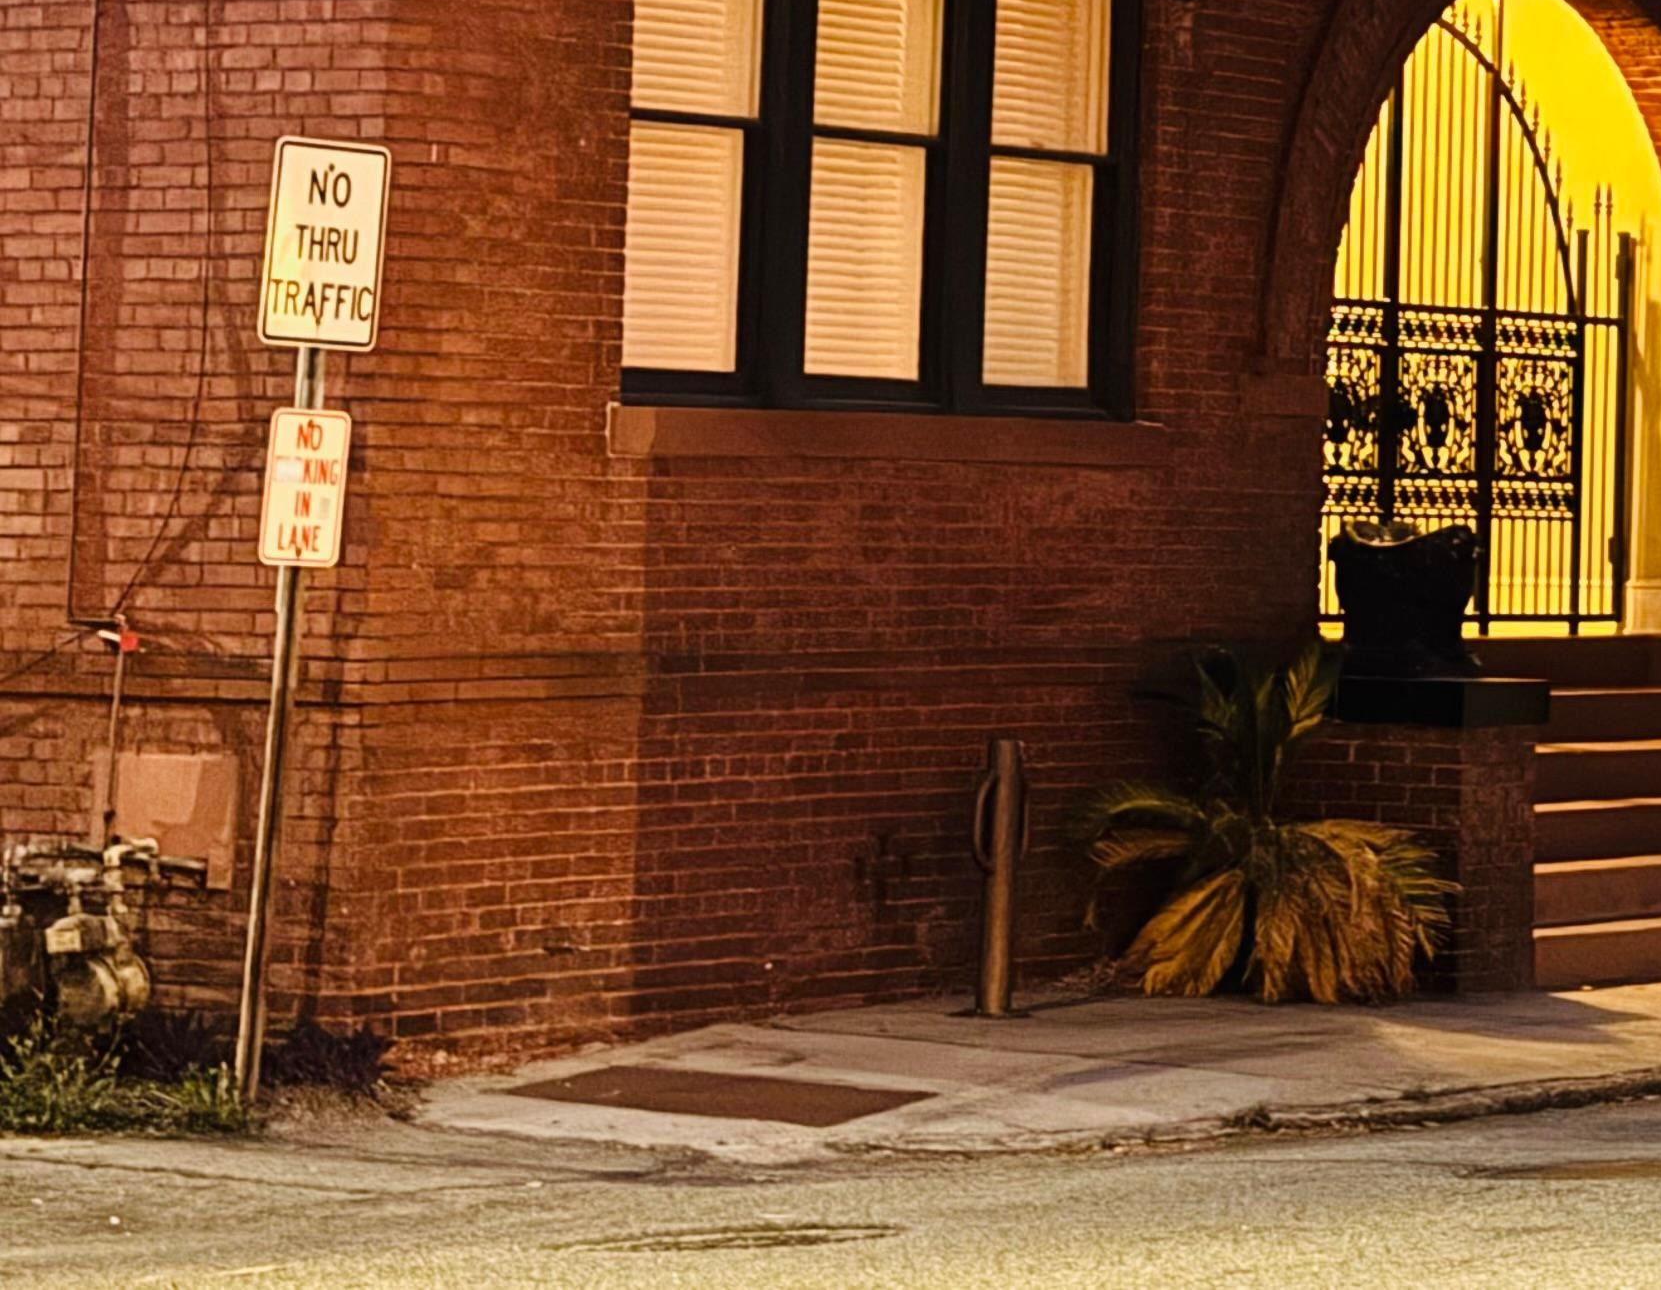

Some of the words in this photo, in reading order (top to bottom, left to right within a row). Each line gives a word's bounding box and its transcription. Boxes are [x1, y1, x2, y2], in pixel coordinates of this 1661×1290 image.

[308, 169, 351, 207] NO
[296, 224, 359, 264] THRU
[270, 279, 374, 321] TRAFFIC
[296, 423, 323, 451] NO
[275, 456, 339, 485] KING
[294, 491, 311, 517] IN
[277, 523, 321, 552] LANE
